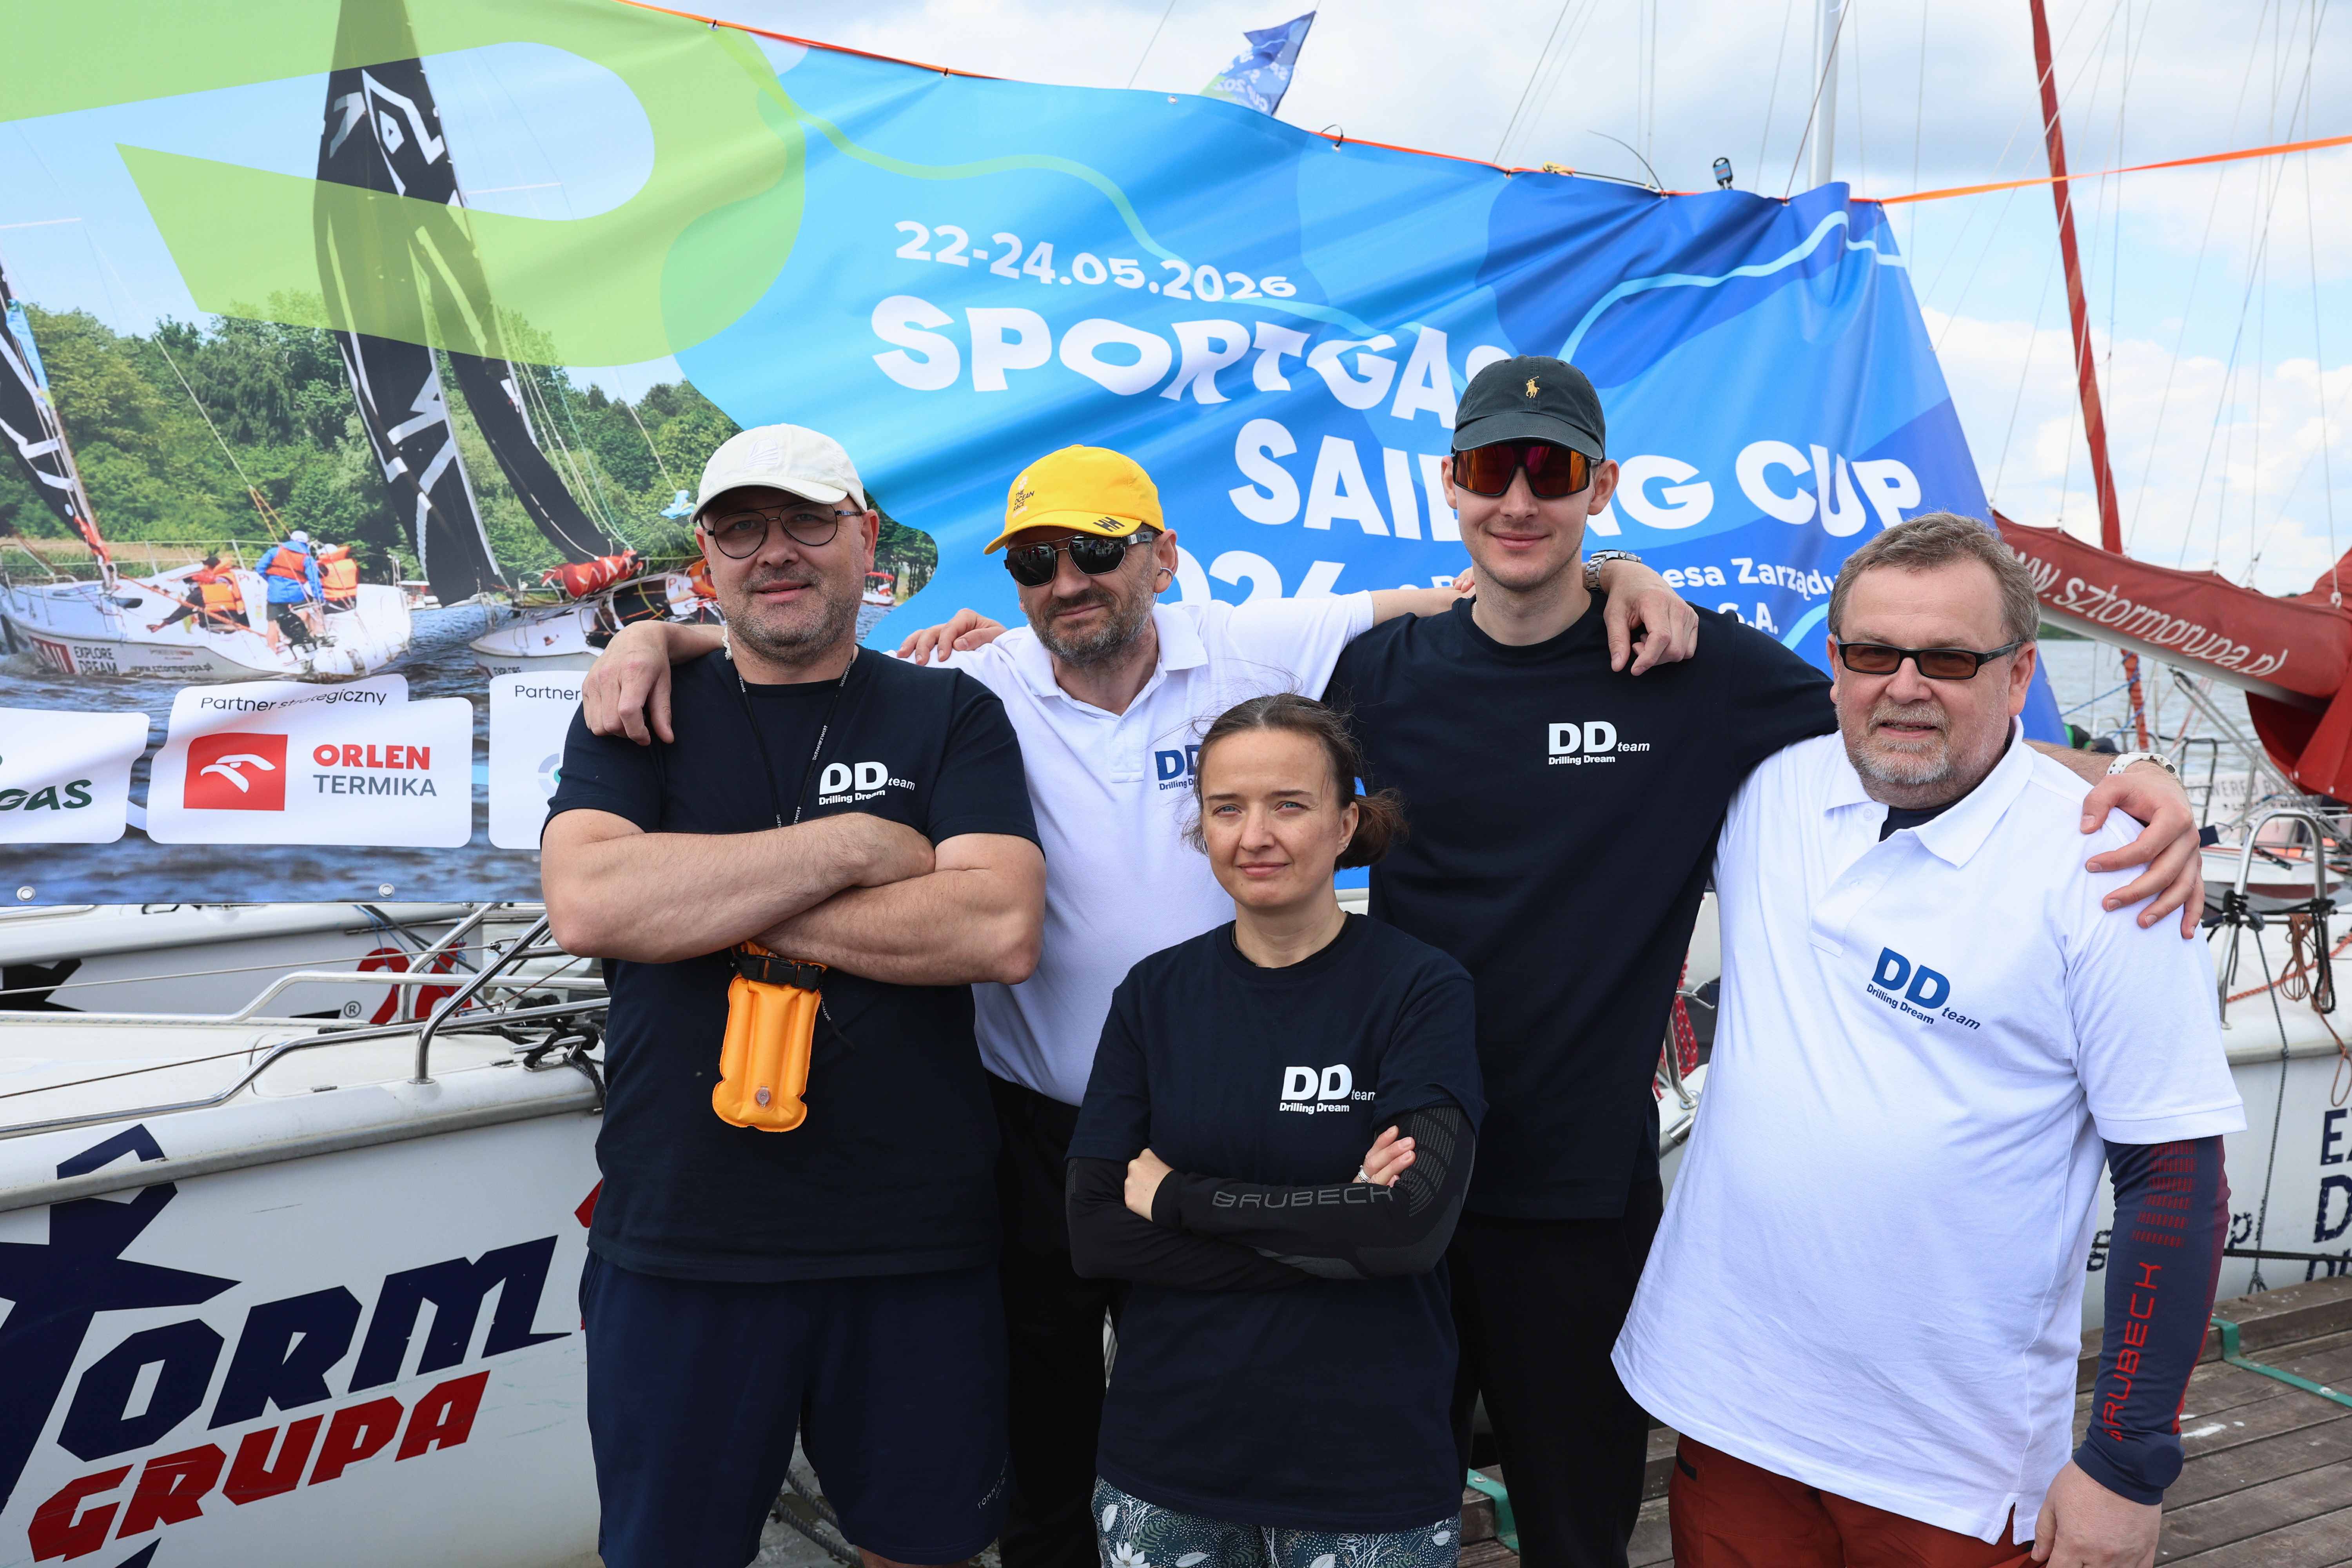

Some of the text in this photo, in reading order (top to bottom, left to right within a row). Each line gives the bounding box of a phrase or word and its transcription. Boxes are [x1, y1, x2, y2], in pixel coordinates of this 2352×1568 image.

[894, 221, 1296, 302] 22-24.05.2026
[1229, 418, 1922, 543] SAILG CUP
[1014, 490, 1035, 505] OCEAN
[1016, 489, 1025, 498] THE
[1013, 501, 1025, 512] RACE
[201, 688, 387, 712] Partner strategiczny
[515, 685, 582, 701] Partner
[1549, 721, 1650, 755] DD team
[313, 744, 430, 770] ORLEN
[1548, 755, 1615, 765] Drilling Dream
[313, 774, 437, 797] TERMIKA
[819, 761, 915, 795] DD team
[1159, 780, 1187, 790] Drilling
[819, 790, 886, 806] Drilling Dream
[1871, 947, 1981, 1030] DD team
[1866, 984, 1935, 1025] Drilling Dream
[1281, 1064, 1352, 1101] DD
[1279, 1102, 1350, 1114] Drilling Dream
[1211, 1186, 1394, 1209] BRUBECK
[27, 1369, 491, 1563] GRUPA
